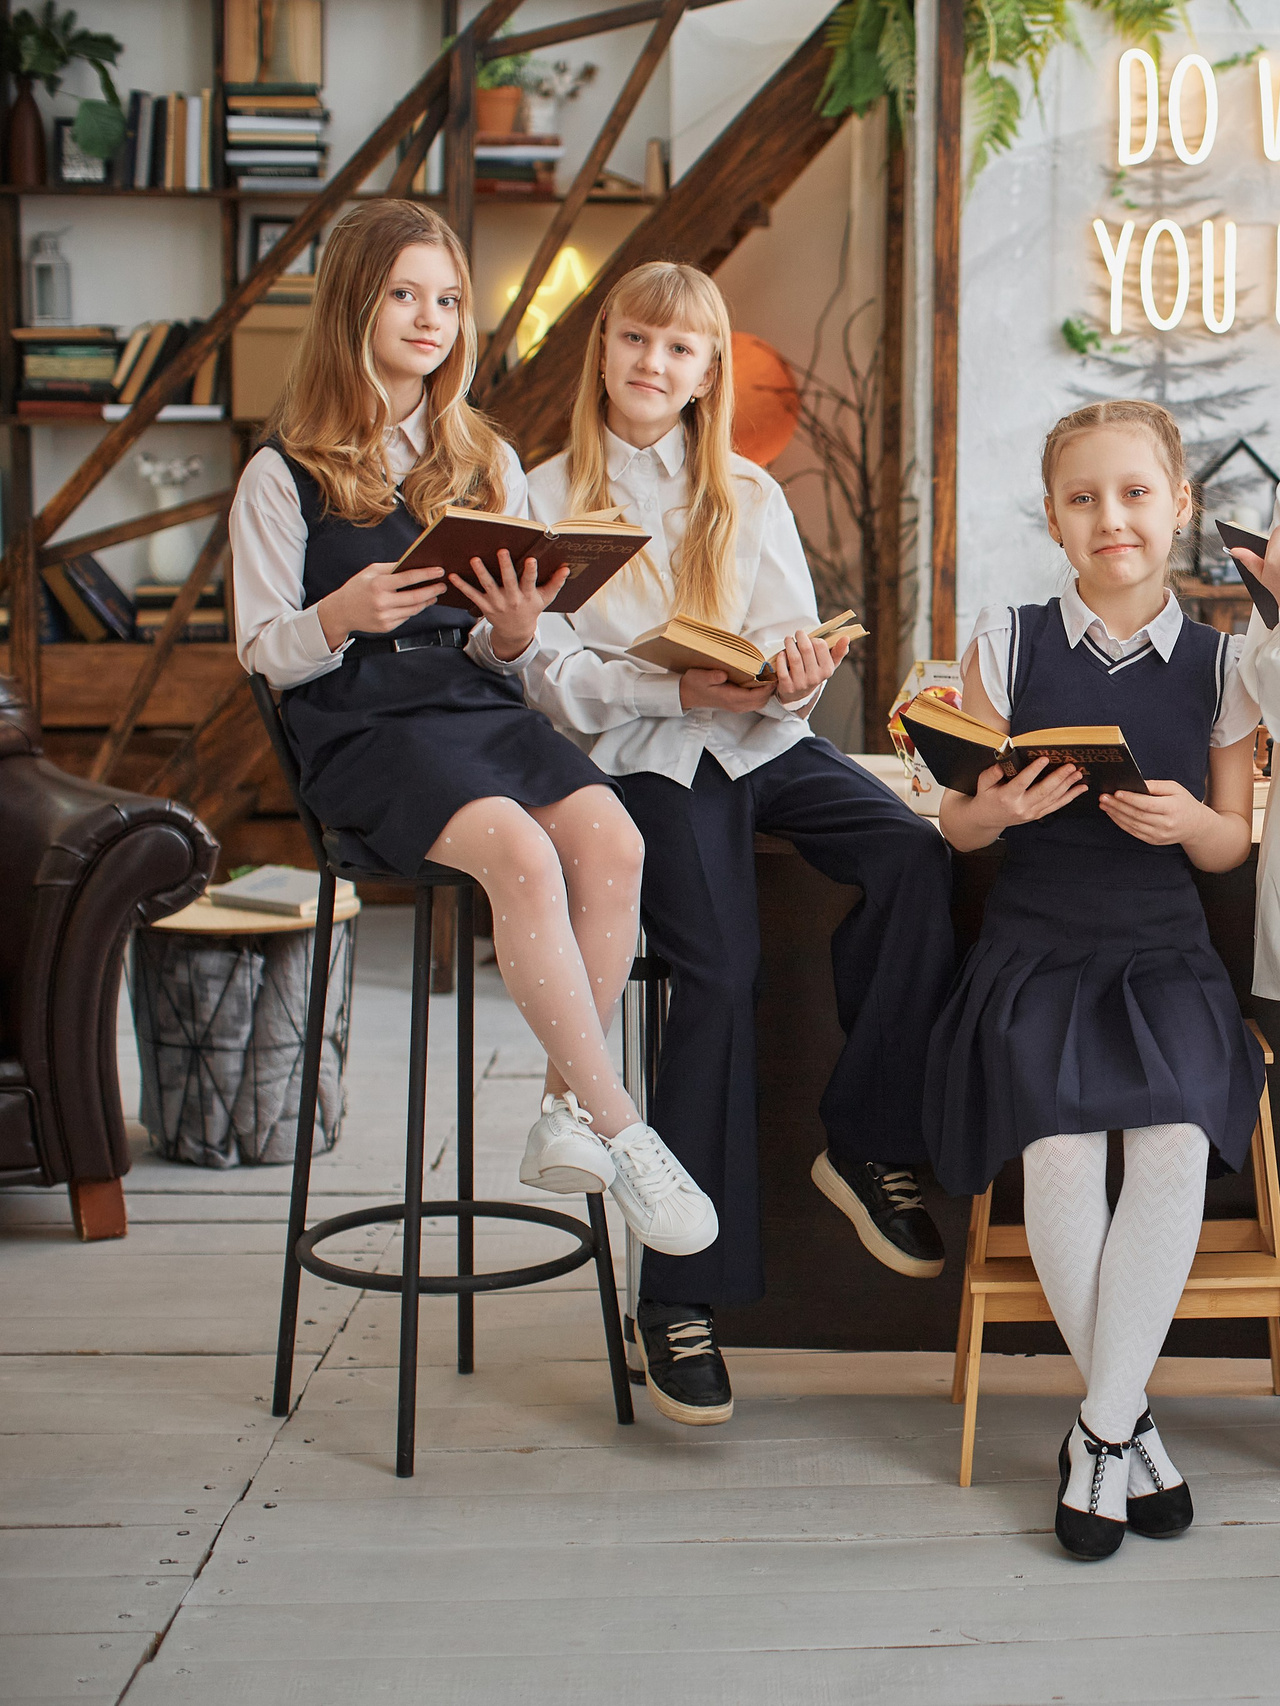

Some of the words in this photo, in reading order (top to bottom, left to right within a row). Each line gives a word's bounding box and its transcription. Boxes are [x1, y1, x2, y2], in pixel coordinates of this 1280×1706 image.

[1118, 48, 1218, 166] DO
[1093, 219, 1236, 335] YOU
[1028, 755, 1124, 764] ВАНОВ
